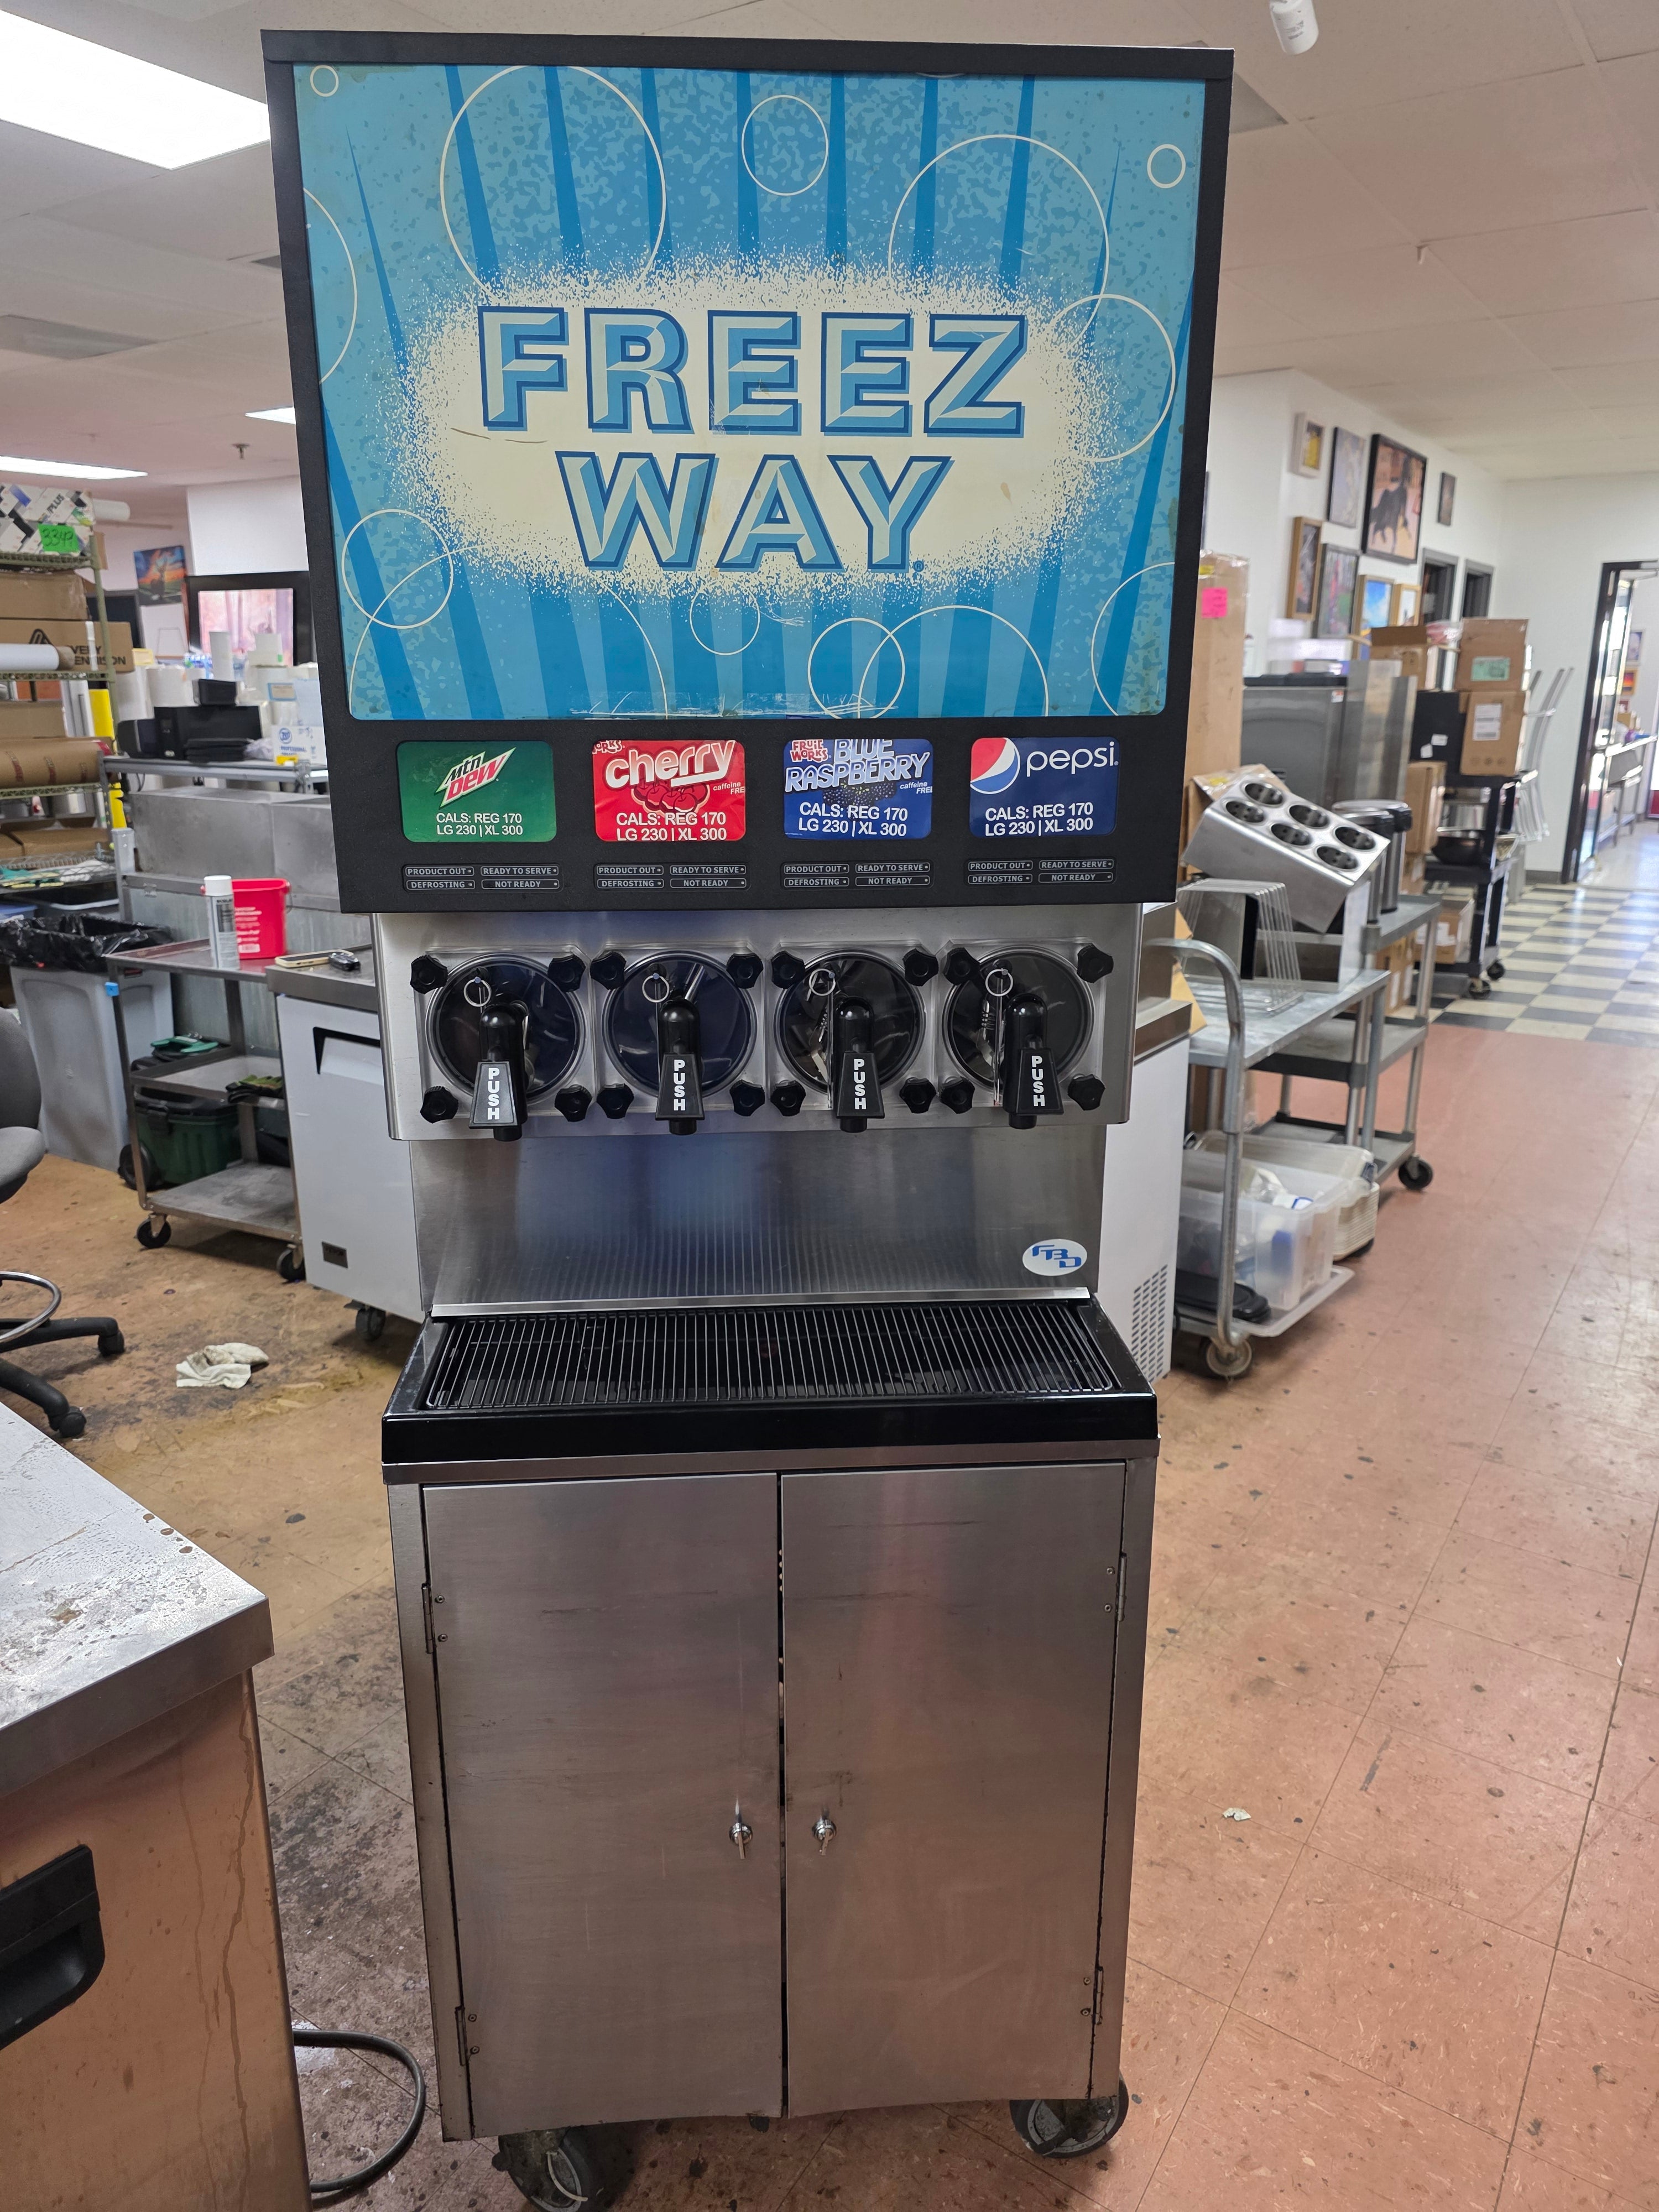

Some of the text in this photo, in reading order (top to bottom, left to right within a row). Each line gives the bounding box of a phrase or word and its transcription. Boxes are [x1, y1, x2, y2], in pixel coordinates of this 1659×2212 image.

[478, 306, 1027, 438] FREEZ
[555, 451, 954, 572] WAY
[790, 748, 828, 763] WORKS
[834, 739, 894, 763] BLUE
[1027, 742, 1114, 776] pepsi
[606, 740, 735, 788] cherry
[785, 752, 930, 792] RASPBERRY
[713, 781, 741, 791] caffeine
[436, 813, 521, 823] CALS: REG 170
[616, 812, 726, 825] CALS: REG 170
[800, 802, 907, 821] CALS: REG 170
[985, 802, 1093, 821] CALS: REG 170
[437, 825, 453, 835] LG
[456, 825, 477, 835] 230
[485, 825, 499, 835] XL
[502, 825, 523, 835] 300
[617, 828, 637, 841] LG
[641, 828, 667, 841] 230
[677, 828, 697, 840] XL
[700, 828, 727, 840] 300
[799, 817, 818, 831] LG
[822, 820, 848, 833] 230
[858, 821, 877, 834] XL
[880, 823, 907, 836] 300
[985, 823, 1005, 836] LG
[1009, 821, 1035, 834] 230
[1045, 819, 1063, 832] XL
[1067, 817, 1093, 831] 300
[673, 1059, 686, 1111] PUSH
[853, 1058, 867, 1110] PUSH
[1031, 1055, 1045, 1107] PUSH
[487, 1067, 500, 1120] PUSH
